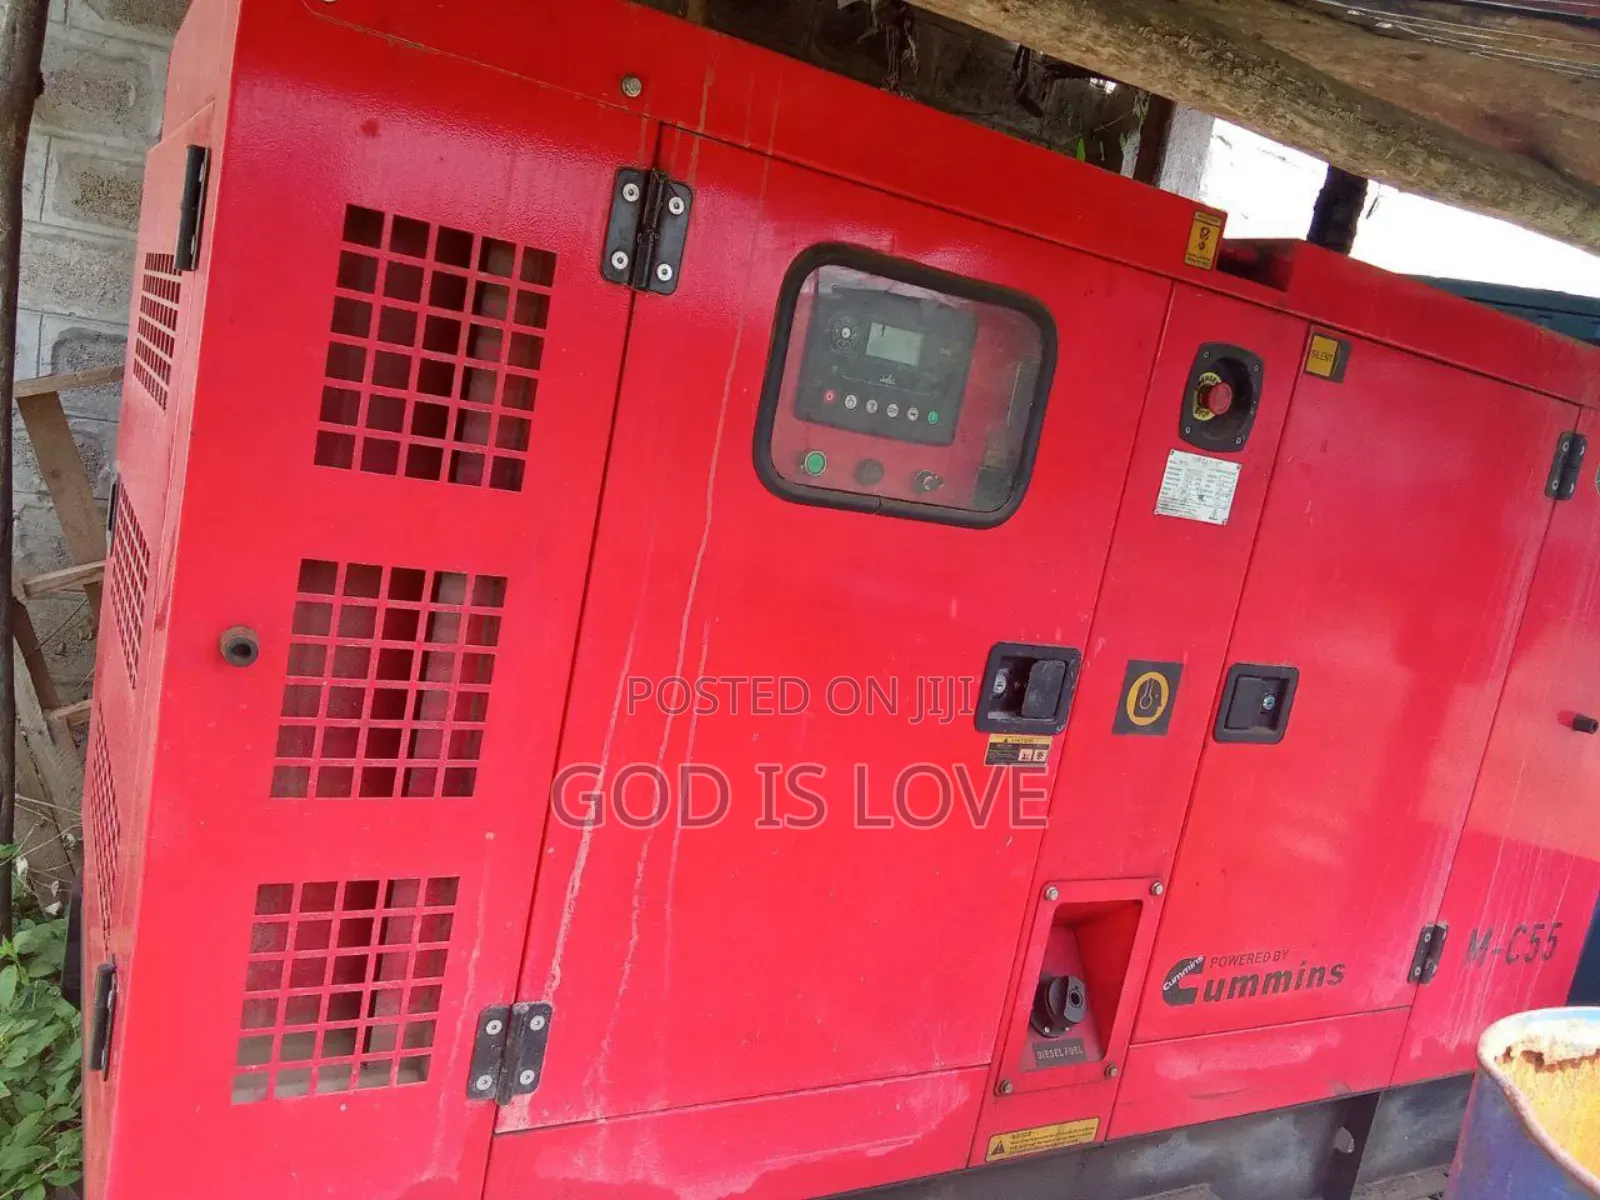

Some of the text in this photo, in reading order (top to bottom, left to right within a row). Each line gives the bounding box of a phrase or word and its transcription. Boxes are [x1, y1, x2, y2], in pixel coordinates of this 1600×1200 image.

[1311, 349, 1334, 363] SILENT
[1464, 922, 1563, 966] M-C55
[1210, 949, 1290, 968] POWERED BY
[1163, 955, 1205, 991] Cummins
[1037, 1048, 1064, 1060] DIESEL
